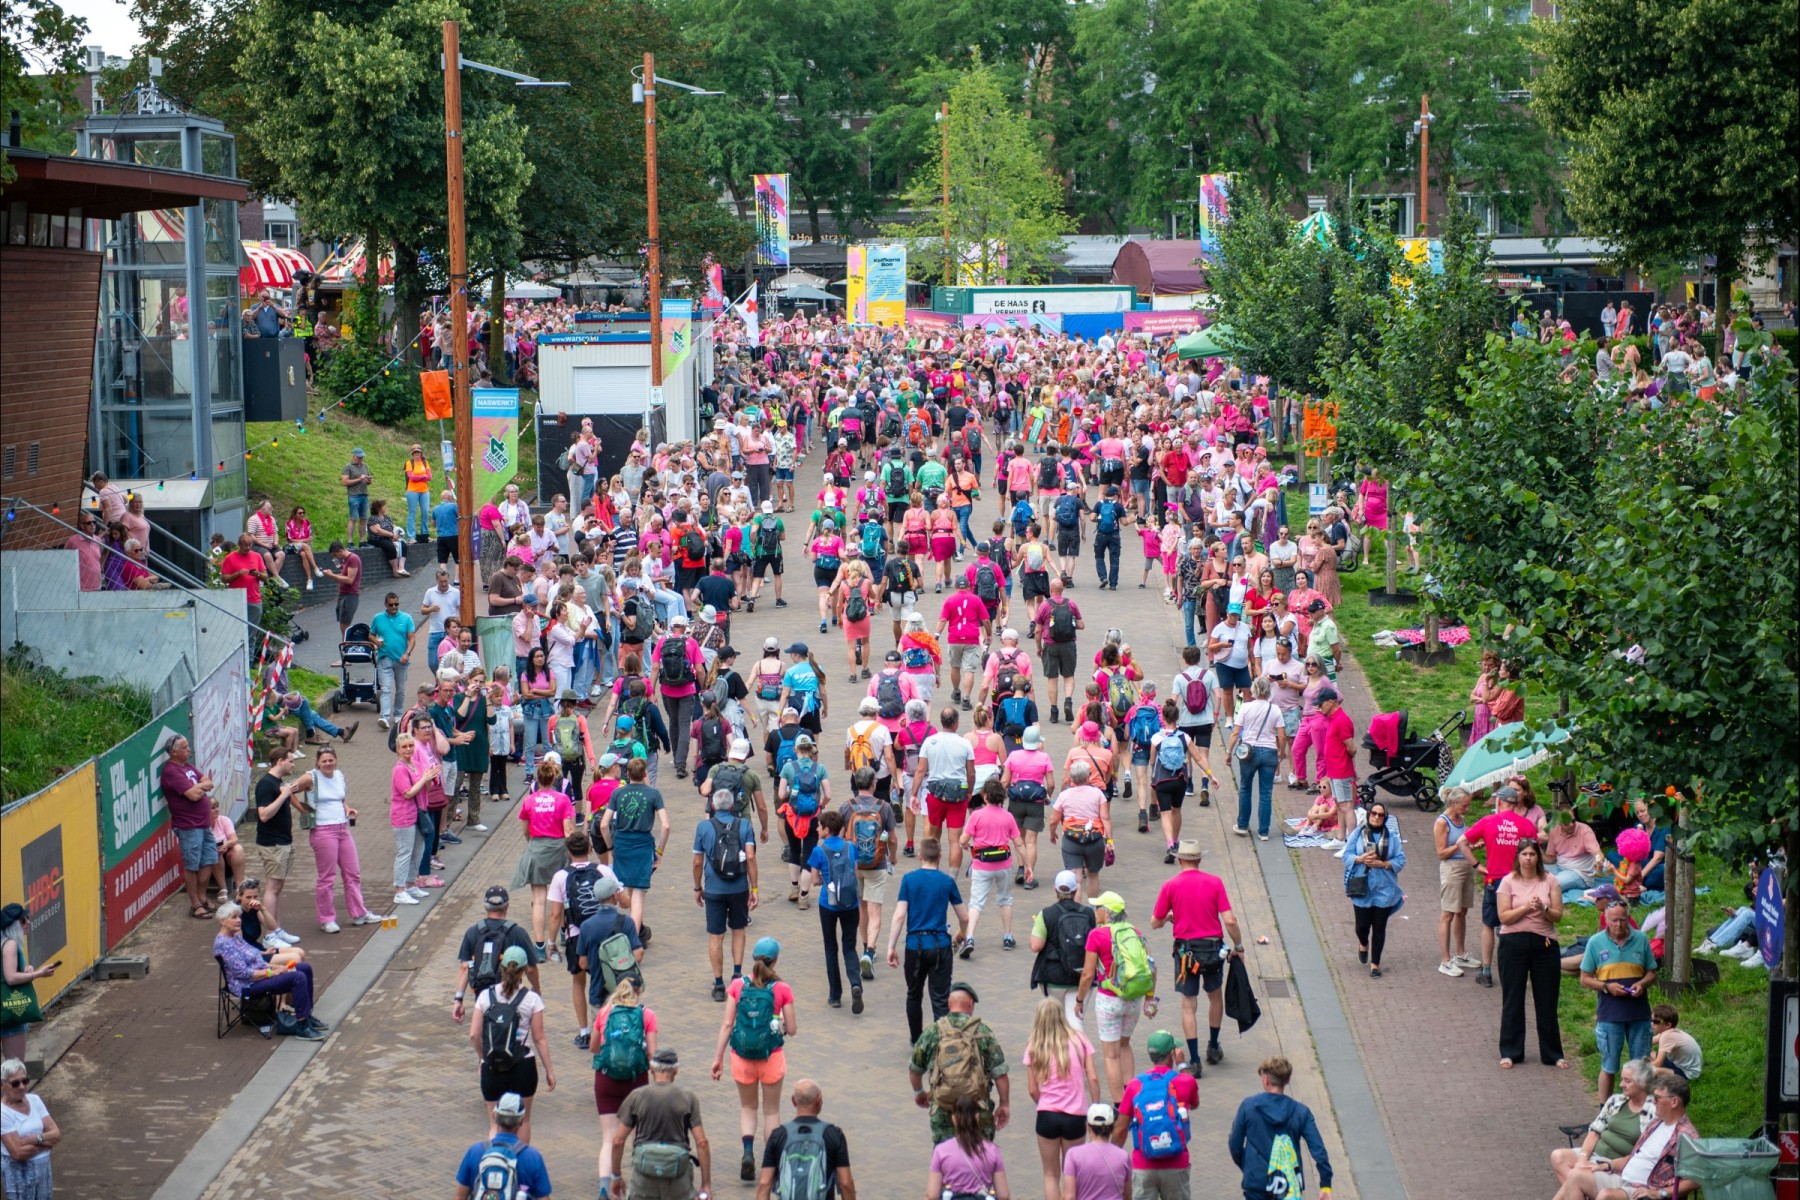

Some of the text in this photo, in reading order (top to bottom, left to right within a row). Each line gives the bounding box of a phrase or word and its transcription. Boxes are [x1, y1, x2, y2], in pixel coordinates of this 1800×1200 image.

[110, 758, 126, 800] van
[535, 796, 555, 804] Walk
[1497, 824, 1518, 832] Walk
[27, 866, 60, 917] WBC
[30, 901, 61, 932] BOUWGROEP
[2, 997, 32, 1008] MANDALA
